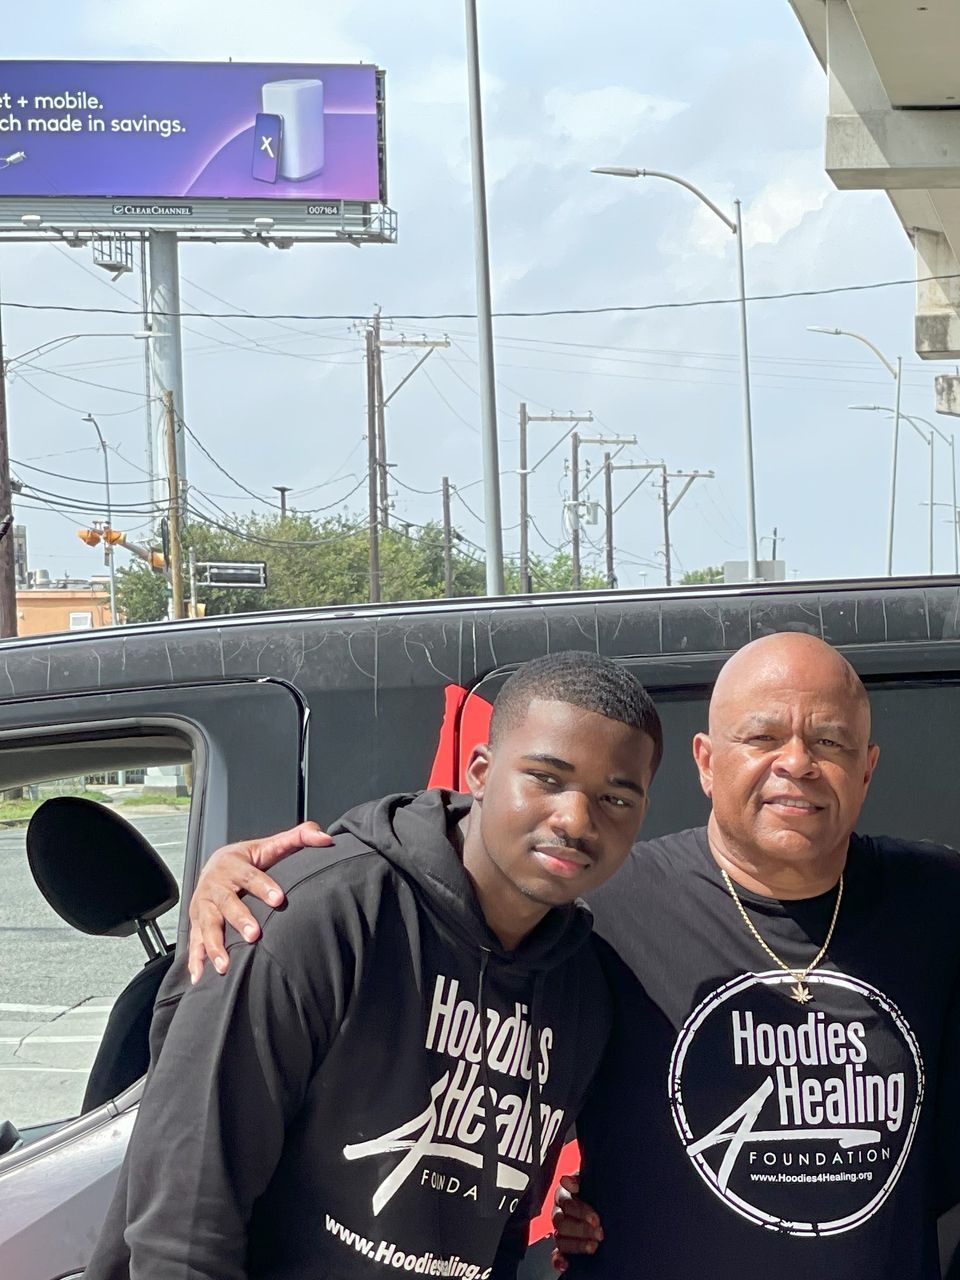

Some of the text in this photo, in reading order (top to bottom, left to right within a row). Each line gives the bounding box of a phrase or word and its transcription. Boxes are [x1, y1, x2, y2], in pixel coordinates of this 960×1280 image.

[0, 93, 12, 109] t
[34, 91, 104, 110] mobile.
[0, 113, 187, 137] ch made in savings.
[731, 1010, 868, 1066] Hoodies
[342, 1070, 530, 1217] 4
[686, 1063, 905, 1195] 4 Healing
[749, 1147, 891, 1166] FOUNDATION
[420, 1169, 519, 1213] FOUNDAIO
[750, 1171, 873, 1184] www.Hoodies4Healing.org
